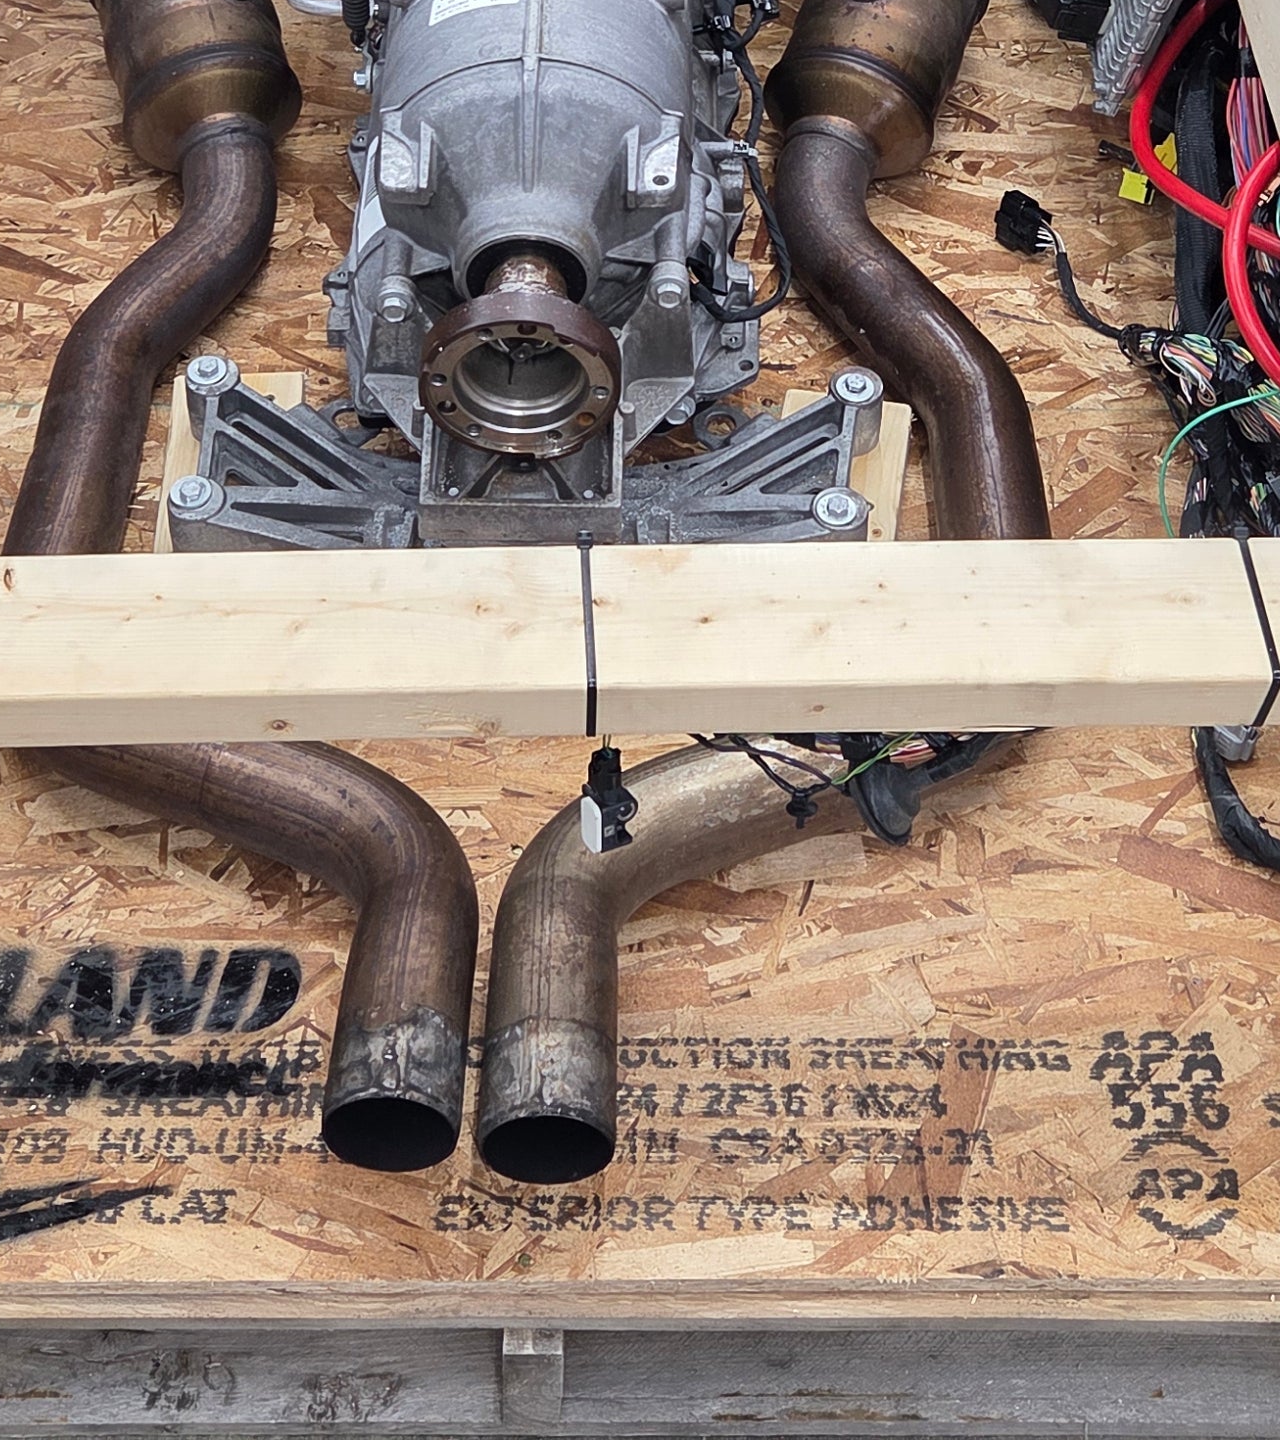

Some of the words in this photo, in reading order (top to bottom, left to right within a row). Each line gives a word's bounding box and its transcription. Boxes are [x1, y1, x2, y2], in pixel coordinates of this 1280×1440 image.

[1106, 1082, 1231, 1131] 556
[1129, 1167, 1241, 1202] APA
[141, 1188, 236, 1224] CAT
[432, 1194, 676, 1232] EXTERIOR
[687, 1193, 815, 1232] TYPE
[832, 1193, 1072, 1232] ADHESIVE
